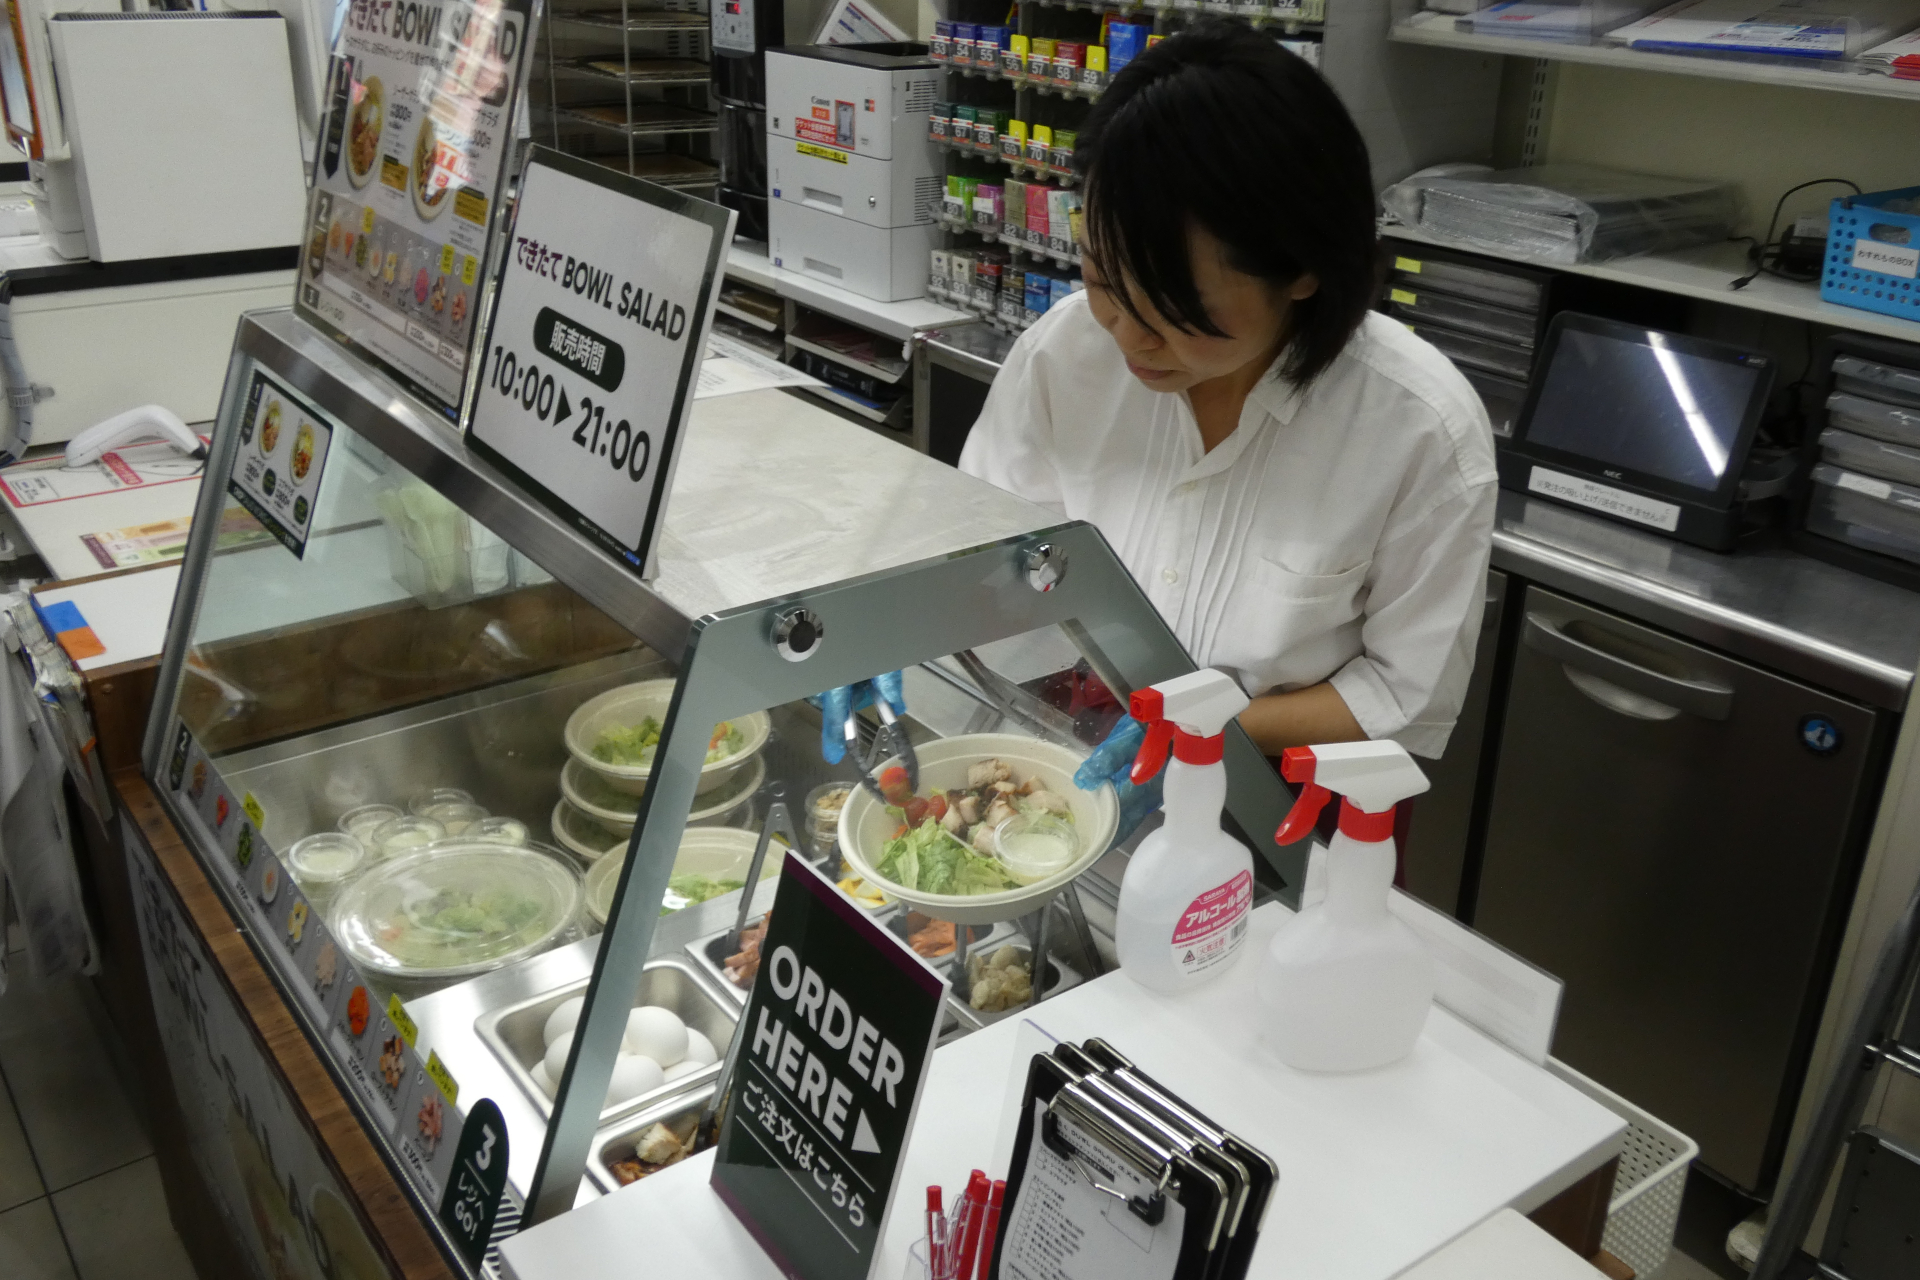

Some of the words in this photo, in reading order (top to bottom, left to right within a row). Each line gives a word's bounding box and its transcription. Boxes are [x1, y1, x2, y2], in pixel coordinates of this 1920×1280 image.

[934, 42, 946, 55] 53
[957, 44, 969, 57] 54
[980, 48, 993, 61] 55
[1005, 58, 1019, 71] 56
[1032, 63, 1045, 76] 57
[1057, 67, 1071, 81] 58
[1083, 71, 1099, 84] 59
[955, 125, 967, 138] 67
[978, 131, 991, 144] 68
[1031, 148, 1043, 161] 70
[1054, 154, 1066, 167] 71
[1004, 223, 1016, 238] 82
[1027, 229, 1040, 244] 83
[1857, 250, 1914, 267] わすれものBOX
[516, 236, 563, 282] できたて
[562, 256, 614, 310] BOWL
[617, 282, 686, 341] SALAD
[549, 320, 607, 376] 販売時間
[491, 345, 555, 421] 10:00
[572, 397, 650, 483] 21:00
[1603, 469, 1622, 480] NEC
[769, 945, 905, 1109] ORDER
[751, 1005, 854, 1142] HERE
[475, 1123, 497, 1171] 3
[742, 1079, 866, 1228] ご注文はこちら
[454, 1200, 477, 1241] GO!
